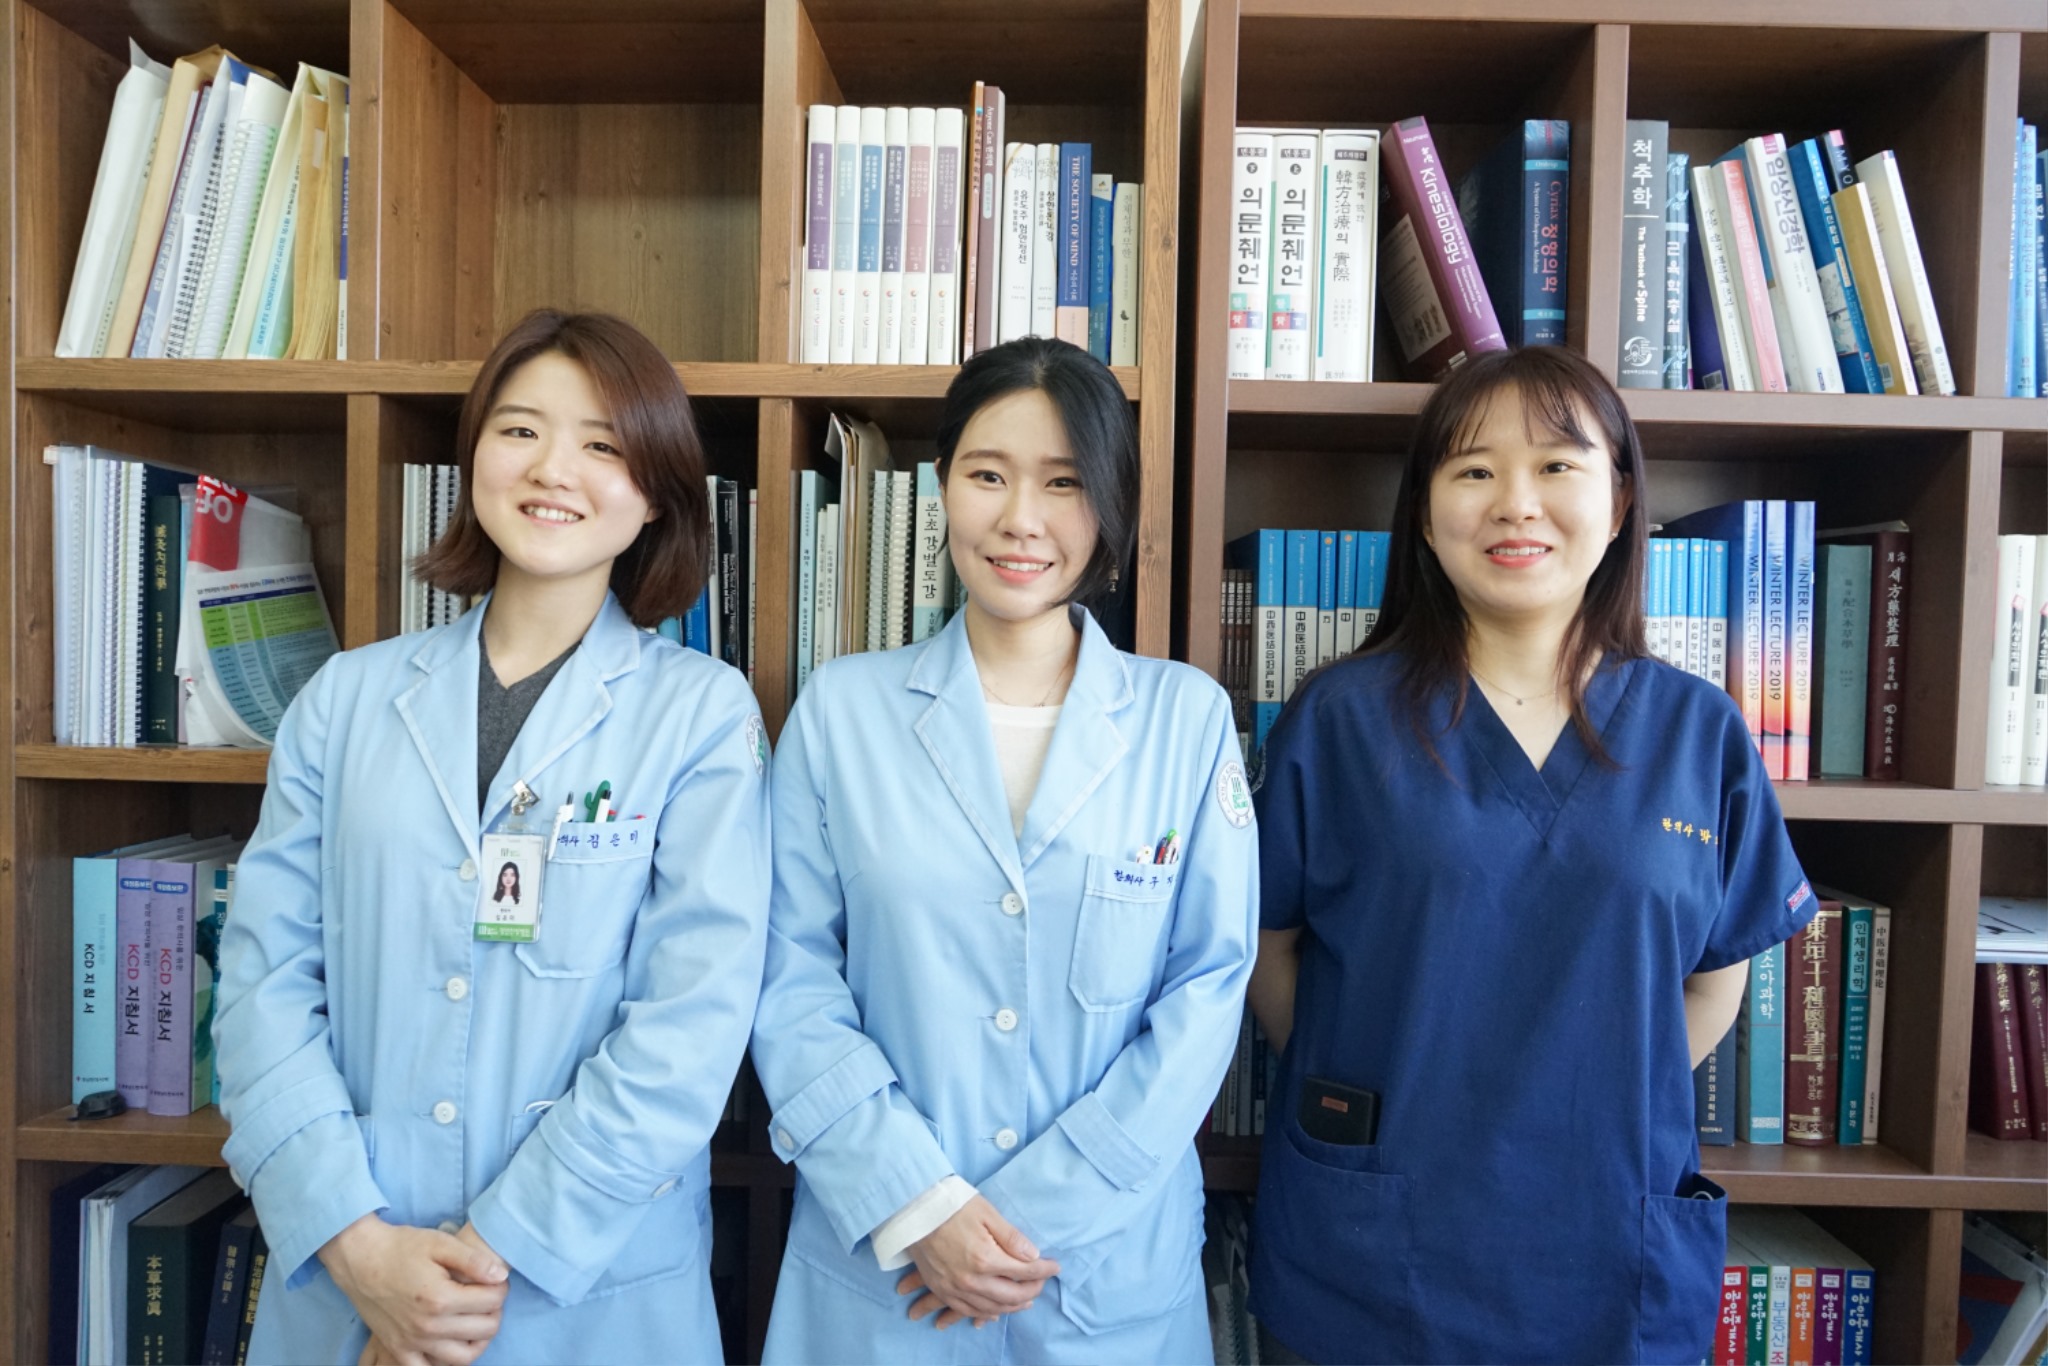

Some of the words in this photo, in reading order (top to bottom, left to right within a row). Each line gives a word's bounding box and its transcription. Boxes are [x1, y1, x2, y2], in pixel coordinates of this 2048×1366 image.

[986, 106, 995, 130] Anyone
[986, 131, 995, 145] Can
[1071, 156, 1080, 176] THE
[1632, 139, 1653, 209] 척추학
[1835, 149, 1854, 186] MYO
[1071, 178, 1080, 221] SOCIETY
[1419, 167, 1462, 265] Kinesiology
[1532, 187, 1540, 206] System
[1549, 180, 1562, 219] Cyriax
[1764, 157, 1805, 255] 임상신경학
[1071, 223, 1080, 238] OF
[1238, 187, 1262, 285] 의문췌언
[1281, 188, 1306, 286] 의문췌언
[1637, 226, 1646, 240] The
[1070, 239, 1080, 266] MIND
[1532, 248, 1540, 274] Medicine
[1541, 224, 1559, 294] 정형의학
[1637, 242, 1646, 277] Textbook
[1635, 289, 1647, 322] Spine
[1637, 279, 1645, 289] of
[1748, 555, 1759, 605] WINTER
[1770, 555, 1783, 605] WINTER
[1797, 555, 1809, 606] WINTER
[1770, 608, 1782, 666] LECTURE
[1796, 609, 1809, 667] LECTURE
[1769, 670, 1781, 701] 2019
[1661, 817, 1694, 838] 한의사
[1114, 869, 1144, 886] 한의사
[84, 943, 95, 969] KCD
[127, 944, 140, 981] KCD
[159, 948, 173, 986] KCD
[1852, 922, 1868, 990] 인체생리학
[83, 972, 95, 1015] 지침서
[124, 985, 140, 1036] 지침서
[157, 990, 173, 1043] 지침서
[1723, 1290, 1741, 1354] 공인중개사
[1751, 1291, 1767, 1341] 공인중개사
[1771, 1301, 1788, 1348] 부동산
[1795, 1291, 1811, 1341] 공인중개사
[1821, 1292, 1838, 1342] 공인중개사
[1848, 1293, 1869, 1356] 공인중개사
